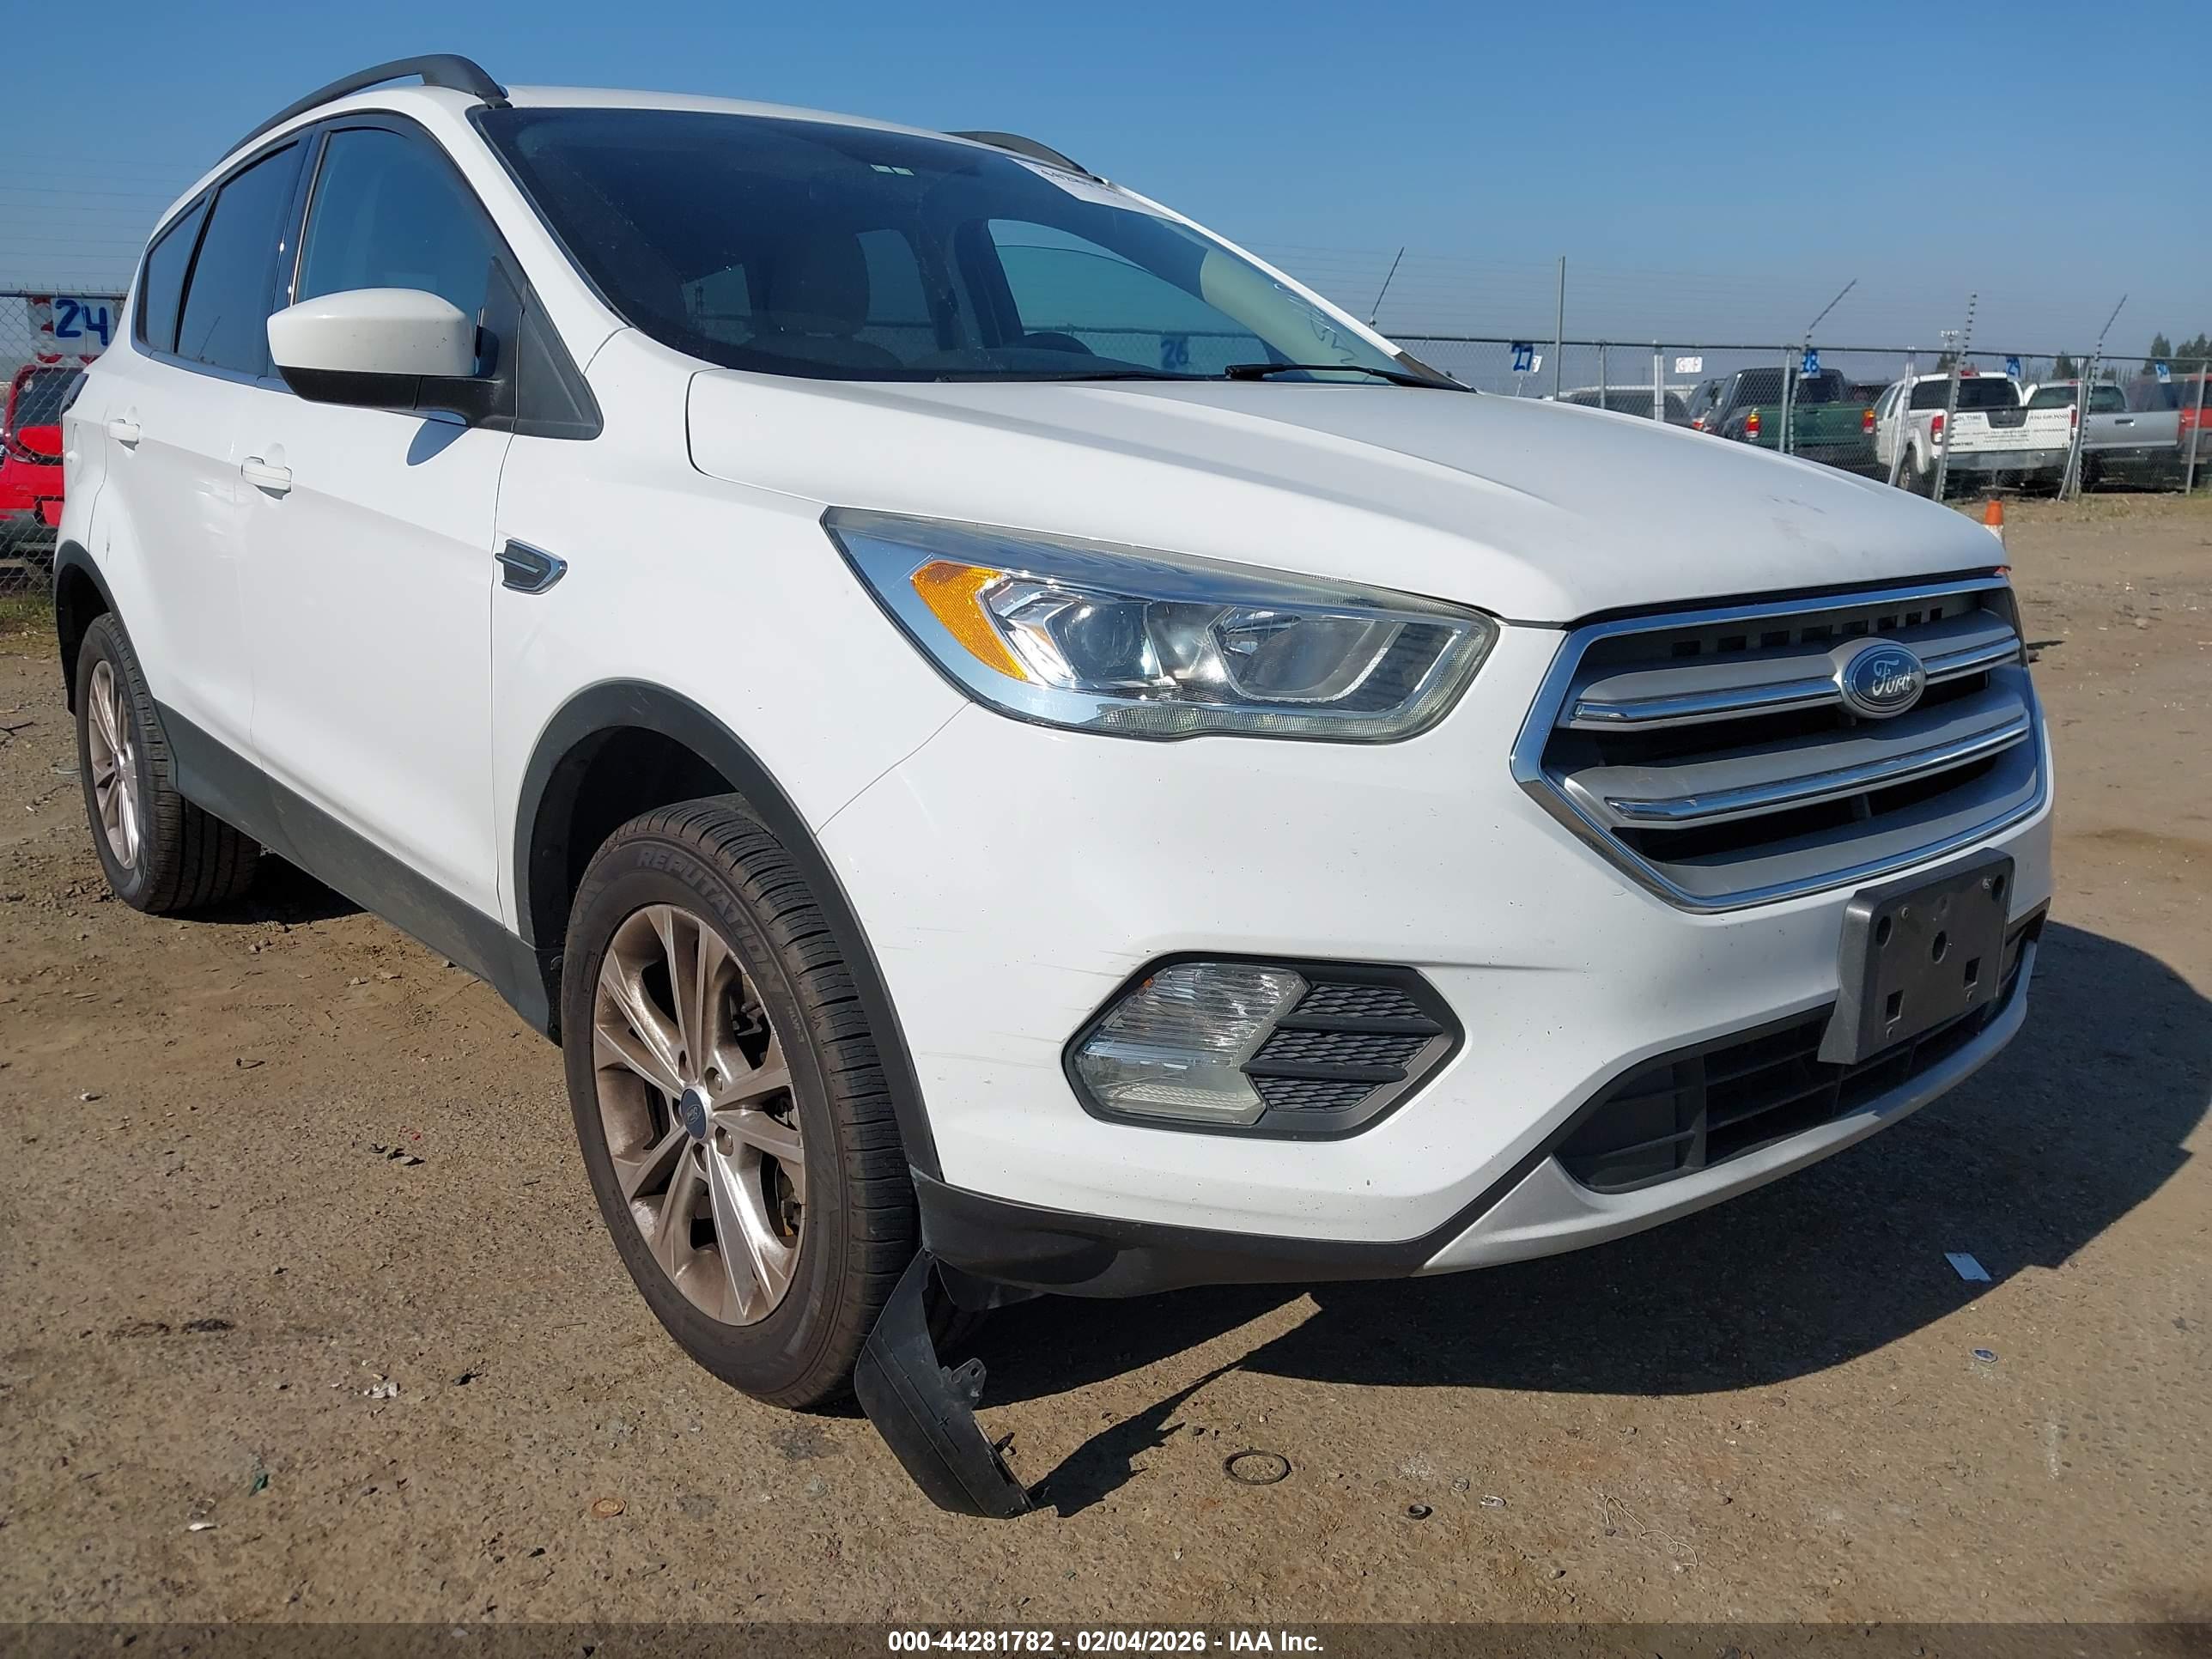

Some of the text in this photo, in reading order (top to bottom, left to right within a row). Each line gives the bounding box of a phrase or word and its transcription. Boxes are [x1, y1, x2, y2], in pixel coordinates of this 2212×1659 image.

[54, 299, 108, 346] 24
[1511, 343, 1533, 371] 27
[1872, 659, 1911, 696] Ford
[636, 847, 786, 994] REPUTATION
